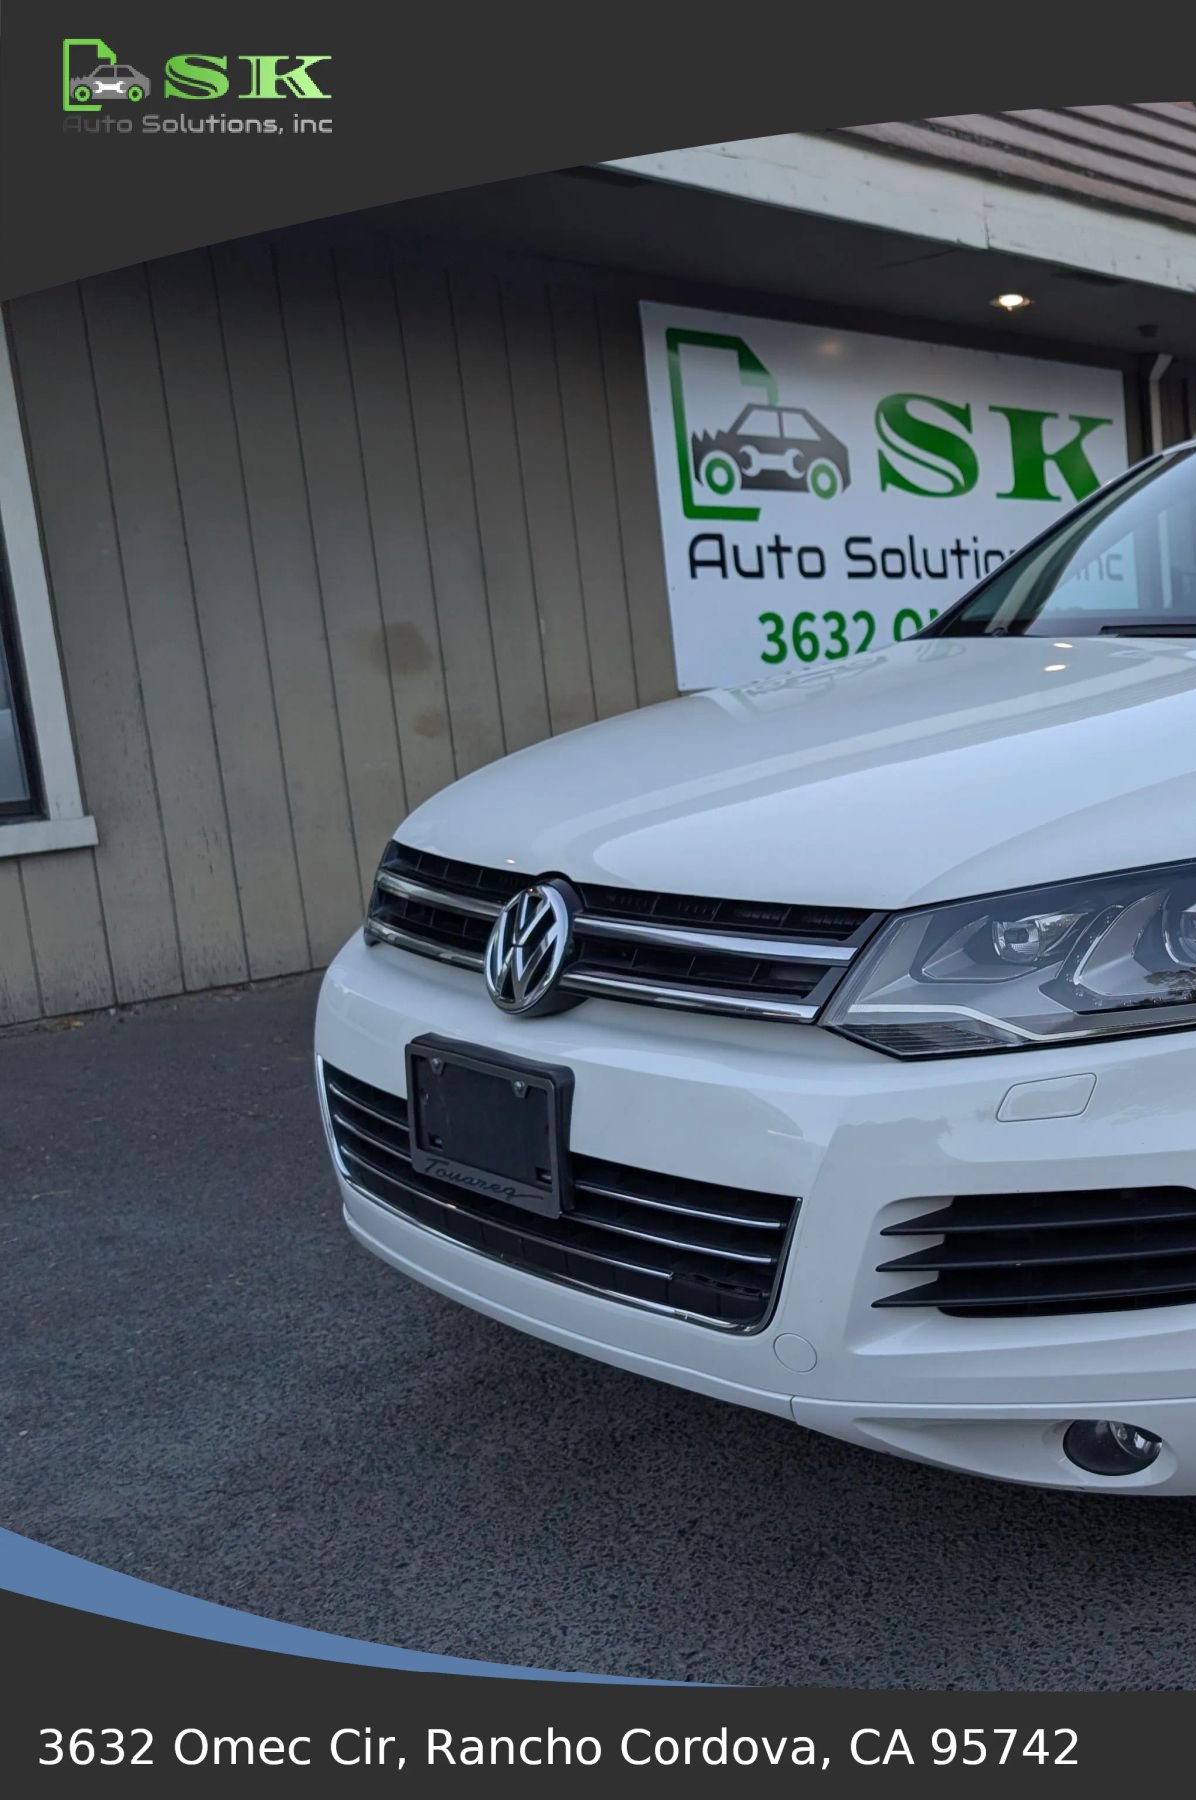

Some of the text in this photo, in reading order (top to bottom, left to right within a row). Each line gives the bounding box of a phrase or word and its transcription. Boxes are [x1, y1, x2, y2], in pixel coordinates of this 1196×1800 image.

[875, 392, 1114, 501] SK
[688, 533, 827, 580] Auto
[757, 609, 877, 665] 3632
